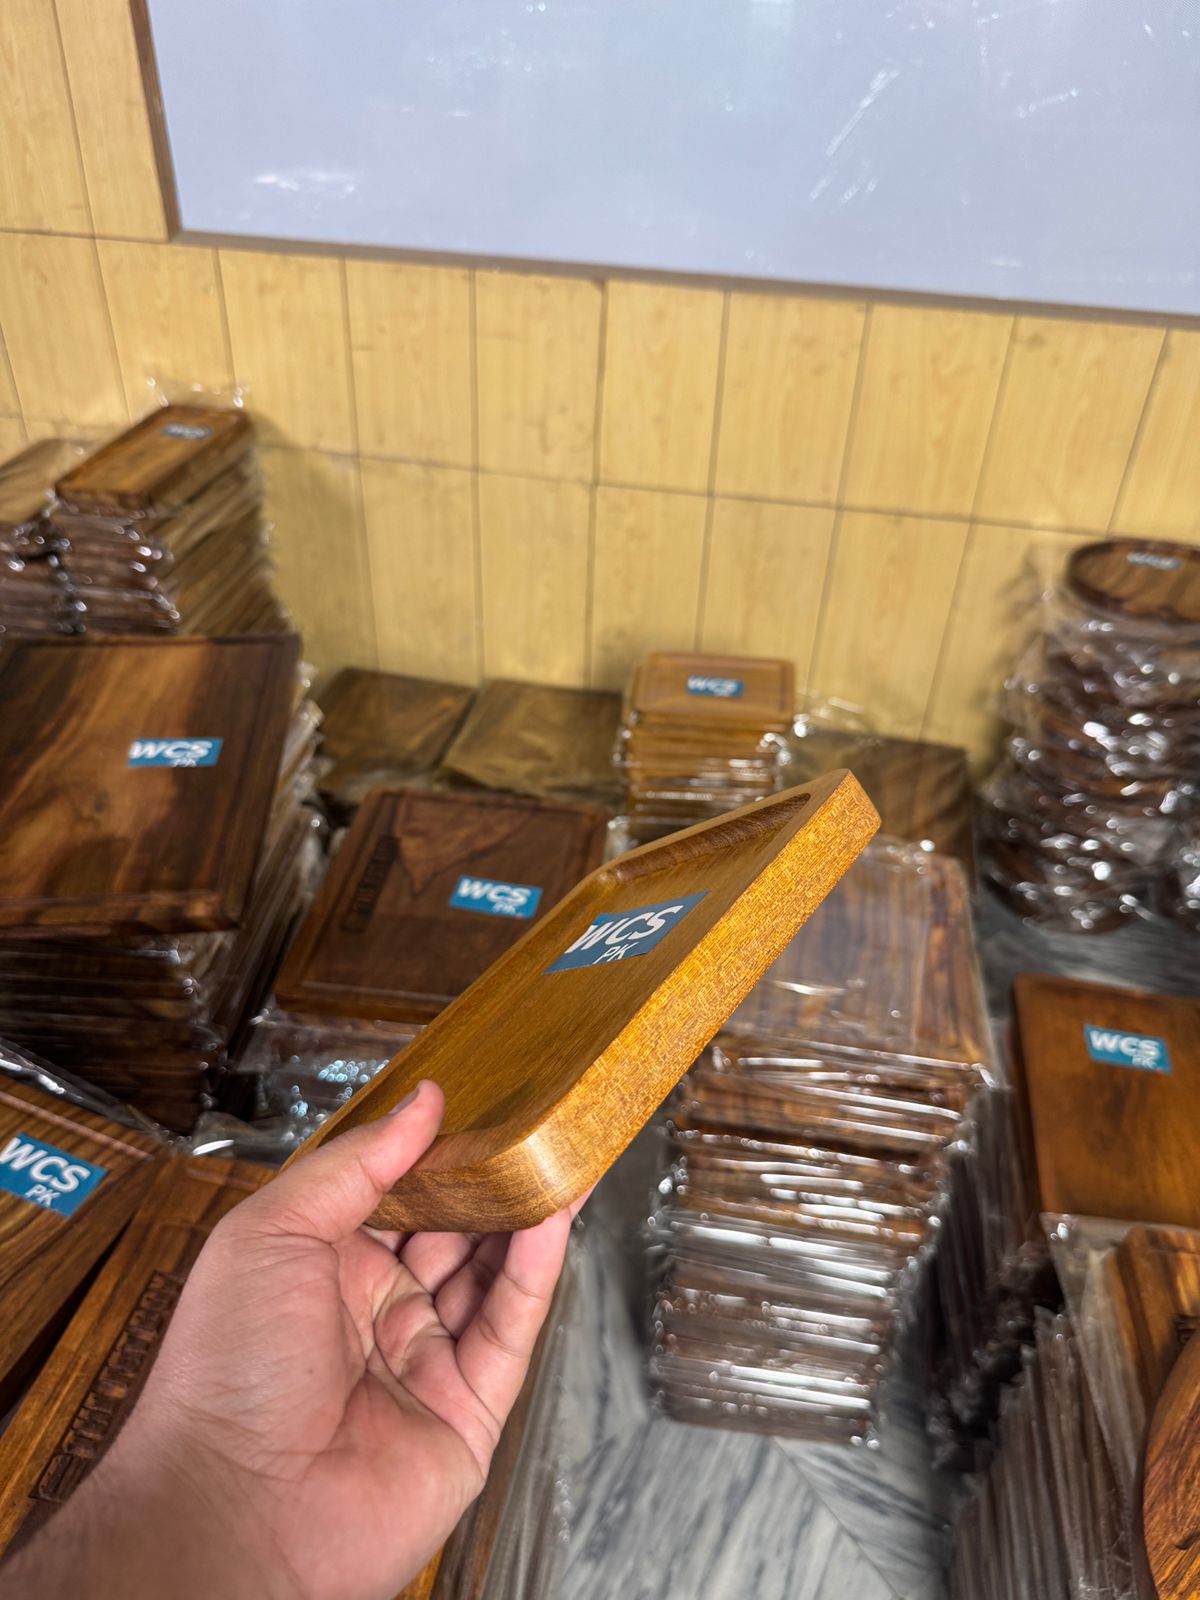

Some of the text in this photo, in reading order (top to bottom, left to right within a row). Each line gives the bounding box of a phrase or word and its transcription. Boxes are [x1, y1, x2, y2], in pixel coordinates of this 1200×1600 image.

[129, 741, 213, 759] WCS
[459, 879, 532, 906] WCS
[565, 905, 684, 954] WCS
[592, 942, 640, 965] PK
[1089, 1030, 1160, 1060] WCS
[0, 1137, 91, 1192] WCS
[25, 1184, 60, 1207] PK
